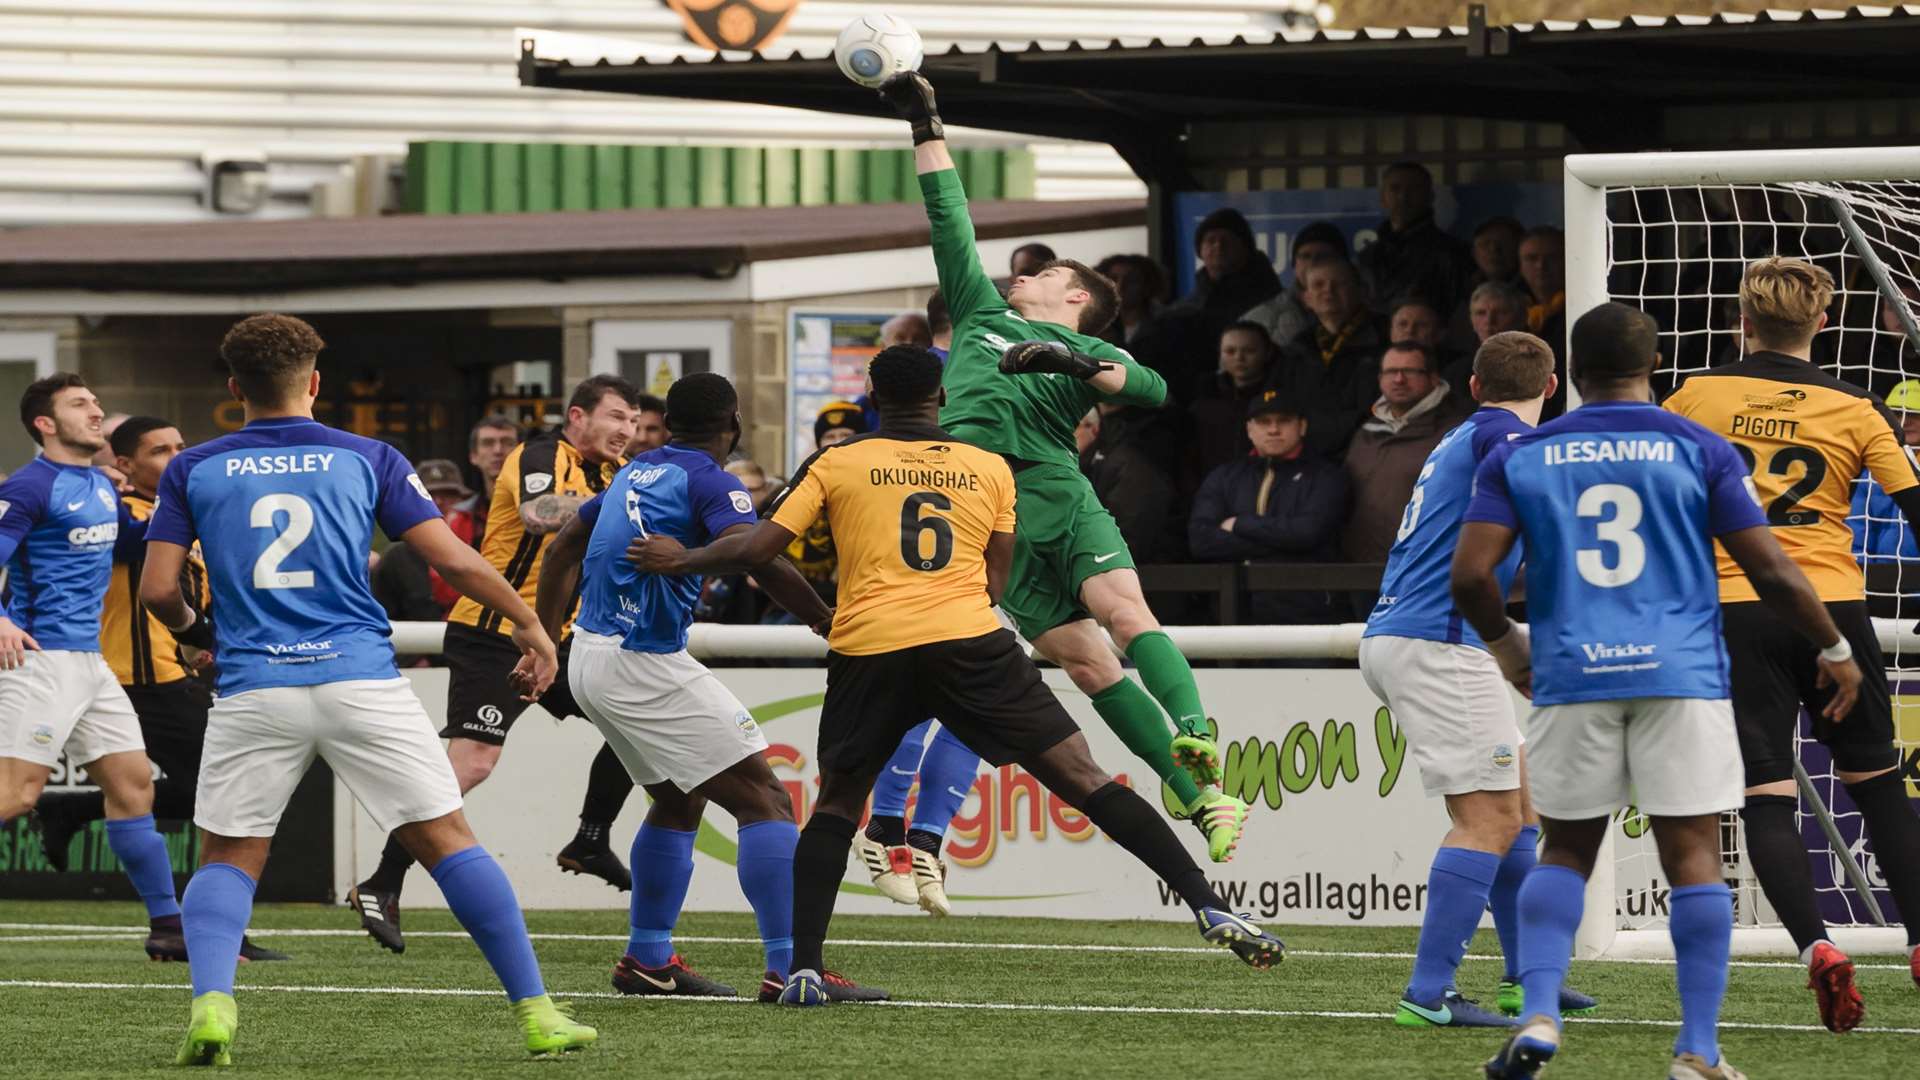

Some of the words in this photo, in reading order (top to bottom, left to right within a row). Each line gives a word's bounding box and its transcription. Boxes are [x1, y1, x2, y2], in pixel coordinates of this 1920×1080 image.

[1731, 415, 1800, 439] PIGOTT
[226, 453, 334, 477] PASSLEY
[1544, 440, 1675, 465] ILESANMI
[627, 467, 668, 485] PRRY
[870, 467, 978, 492] OKUONGHAE
[250, 493, 315, 589] 2
[900, 491, 954, 572] 6
[1575, 483, 1646, 588] 3
[265, 640, 333, 656] Viridor
[1580, 642, 1657, 662] Viridor
[1156, 872, 1427, 920] ww.gallagher
